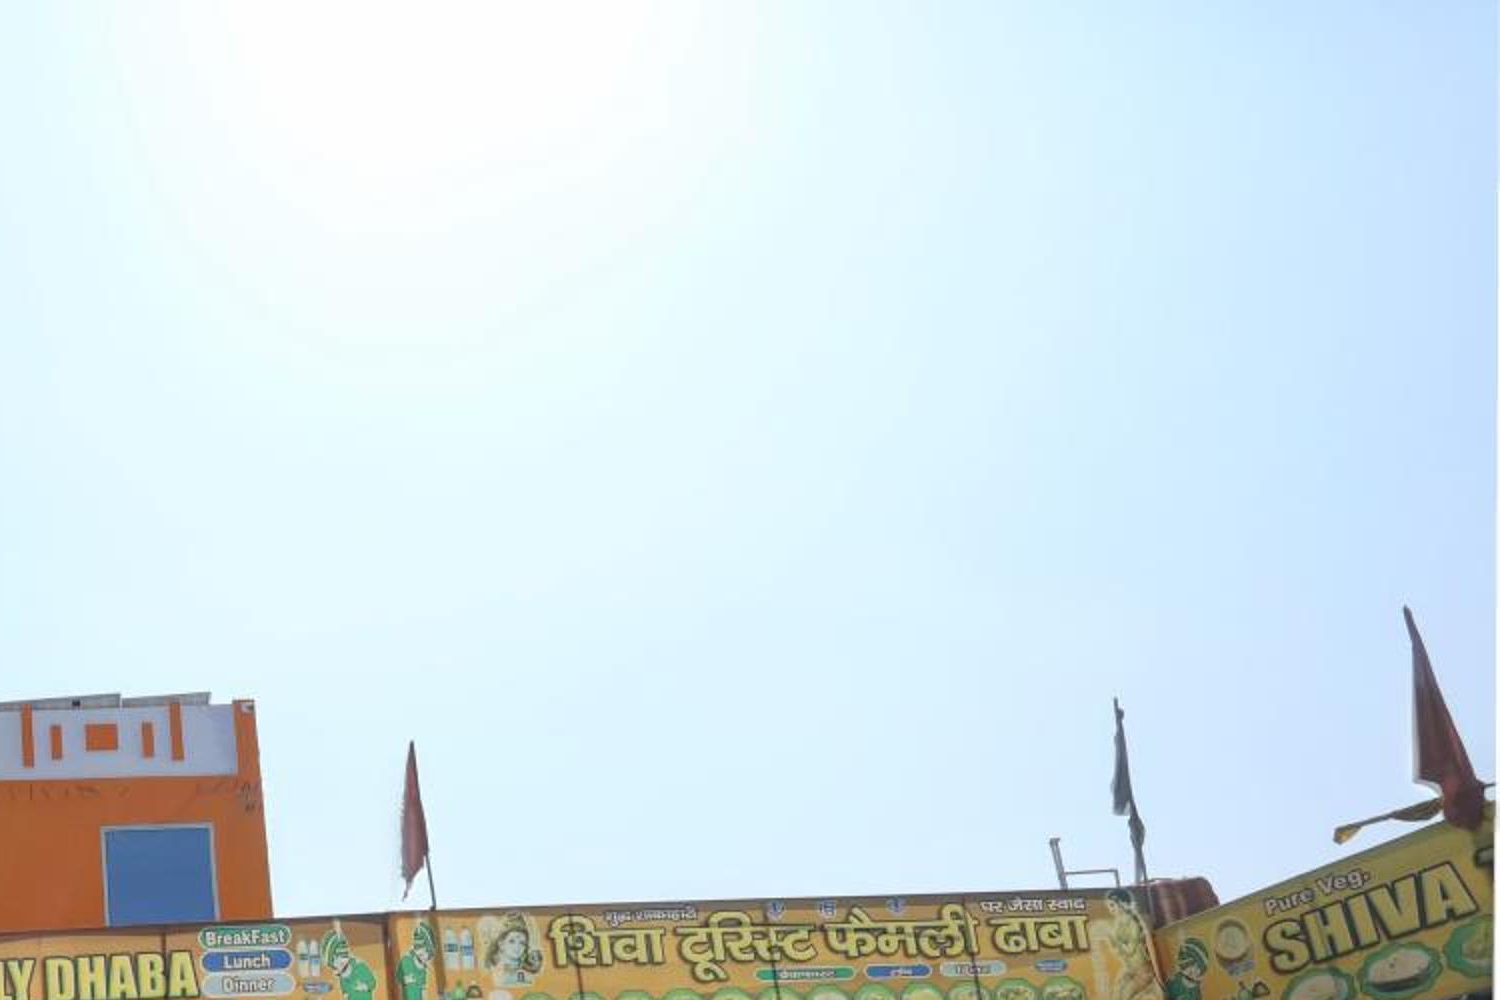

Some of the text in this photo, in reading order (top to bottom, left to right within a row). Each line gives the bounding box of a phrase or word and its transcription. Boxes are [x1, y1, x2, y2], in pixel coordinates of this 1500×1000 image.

[1263, 868, 1371, 916] Pure Veg.
[1263, 861, 1479, 975] SHIVA
[203, 928, 287, 946] BreakFast
[548, 914, 666, 967] शिवा
[676, 911, 818, 982] टूरिस्ट
[990, 914, 1090, 953] ढाबा
[222, 952, 272, 970] Lunch
[220, 976, 276, 994] Dinner
